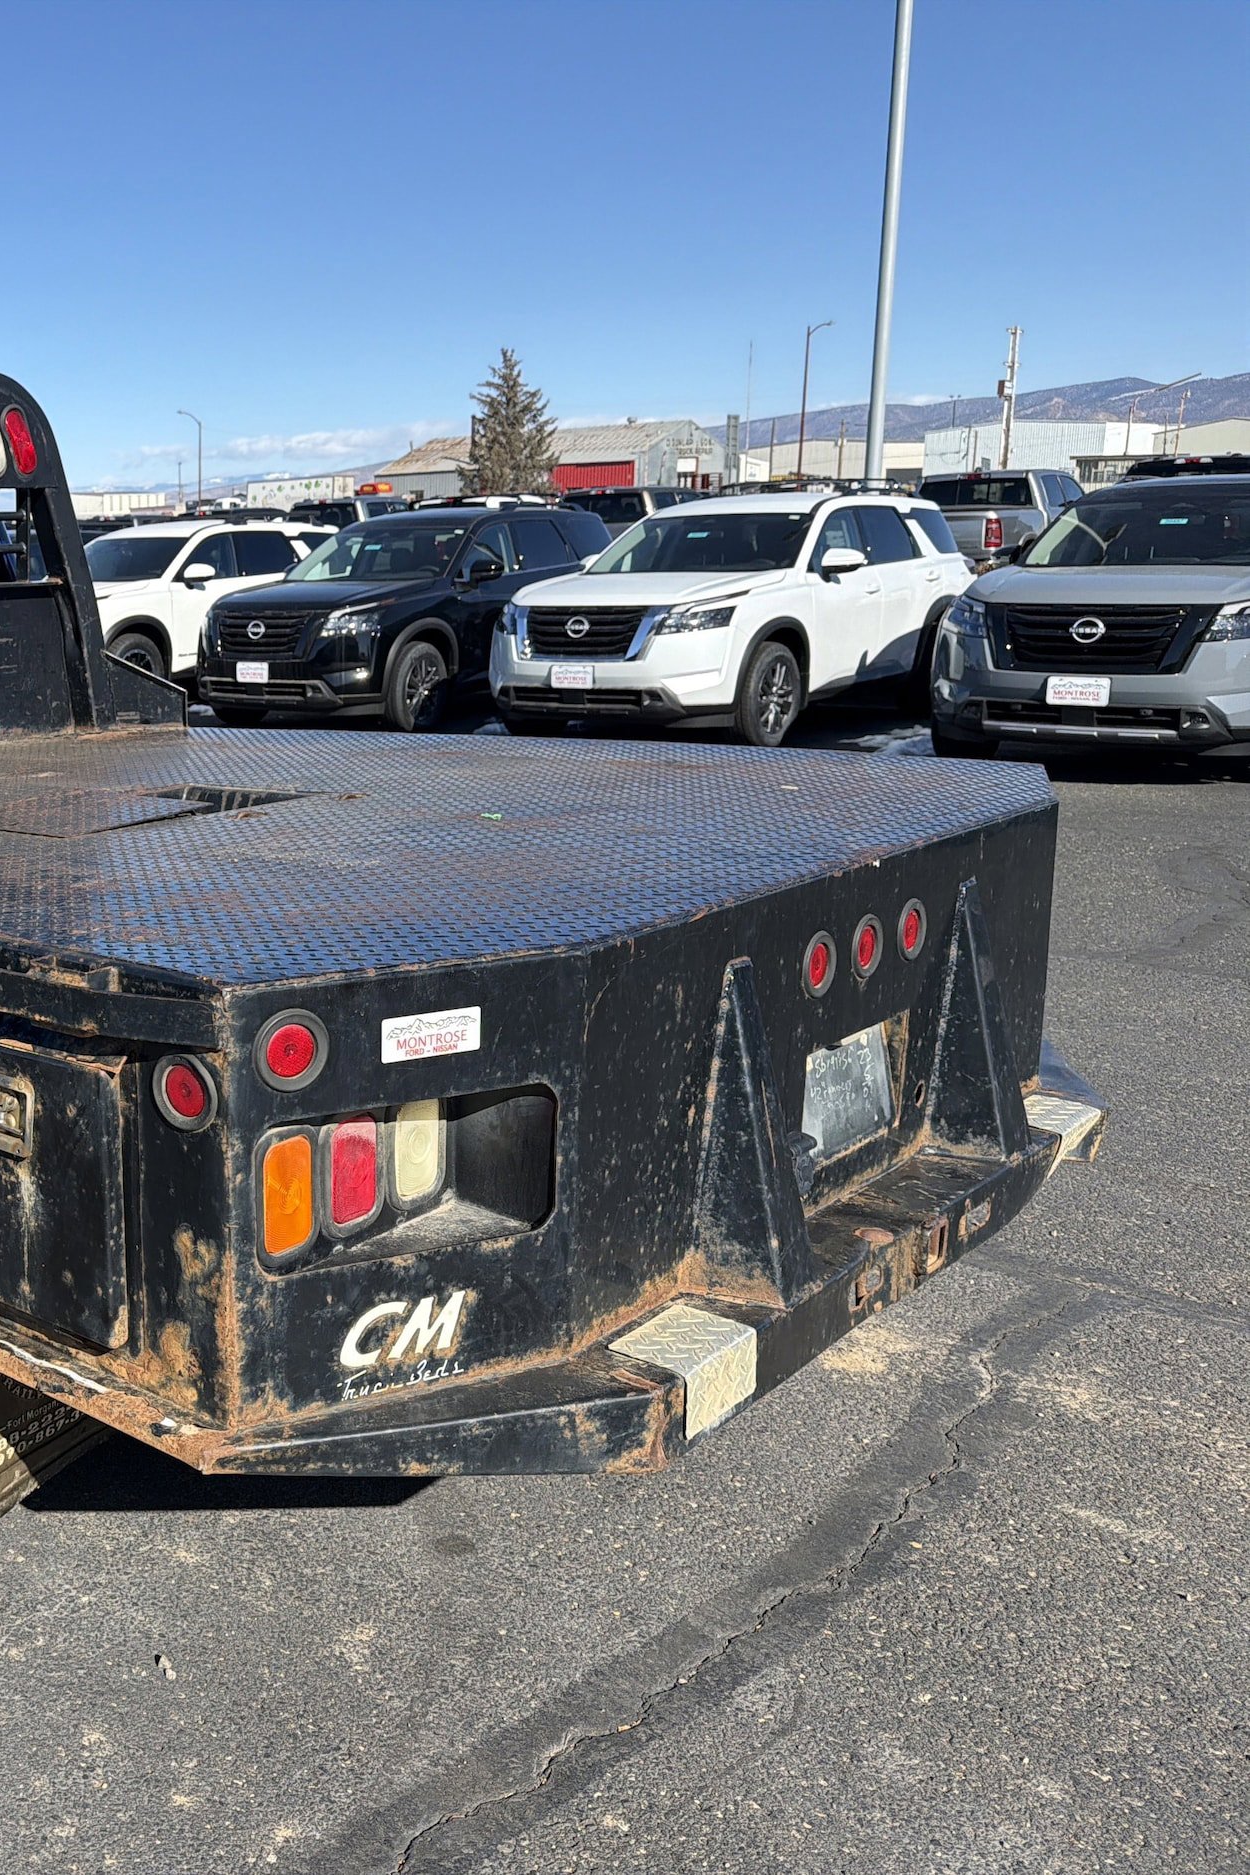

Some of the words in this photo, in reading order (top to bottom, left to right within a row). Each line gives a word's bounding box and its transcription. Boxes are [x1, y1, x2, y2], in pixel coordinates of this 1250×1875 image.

[1069, 626, 1106, 634] NISSAN
[1052, 689, 1101, 698] MONTROSE
[396, 1029, 468, 1051] MONTROSE
[405, 1047, 425, 1057] FORD
[432, 1043, 459, 1053] NISSAN
[339, 1290, 466, 1368] CM
[6, 1414, 26, 1429] Fort
